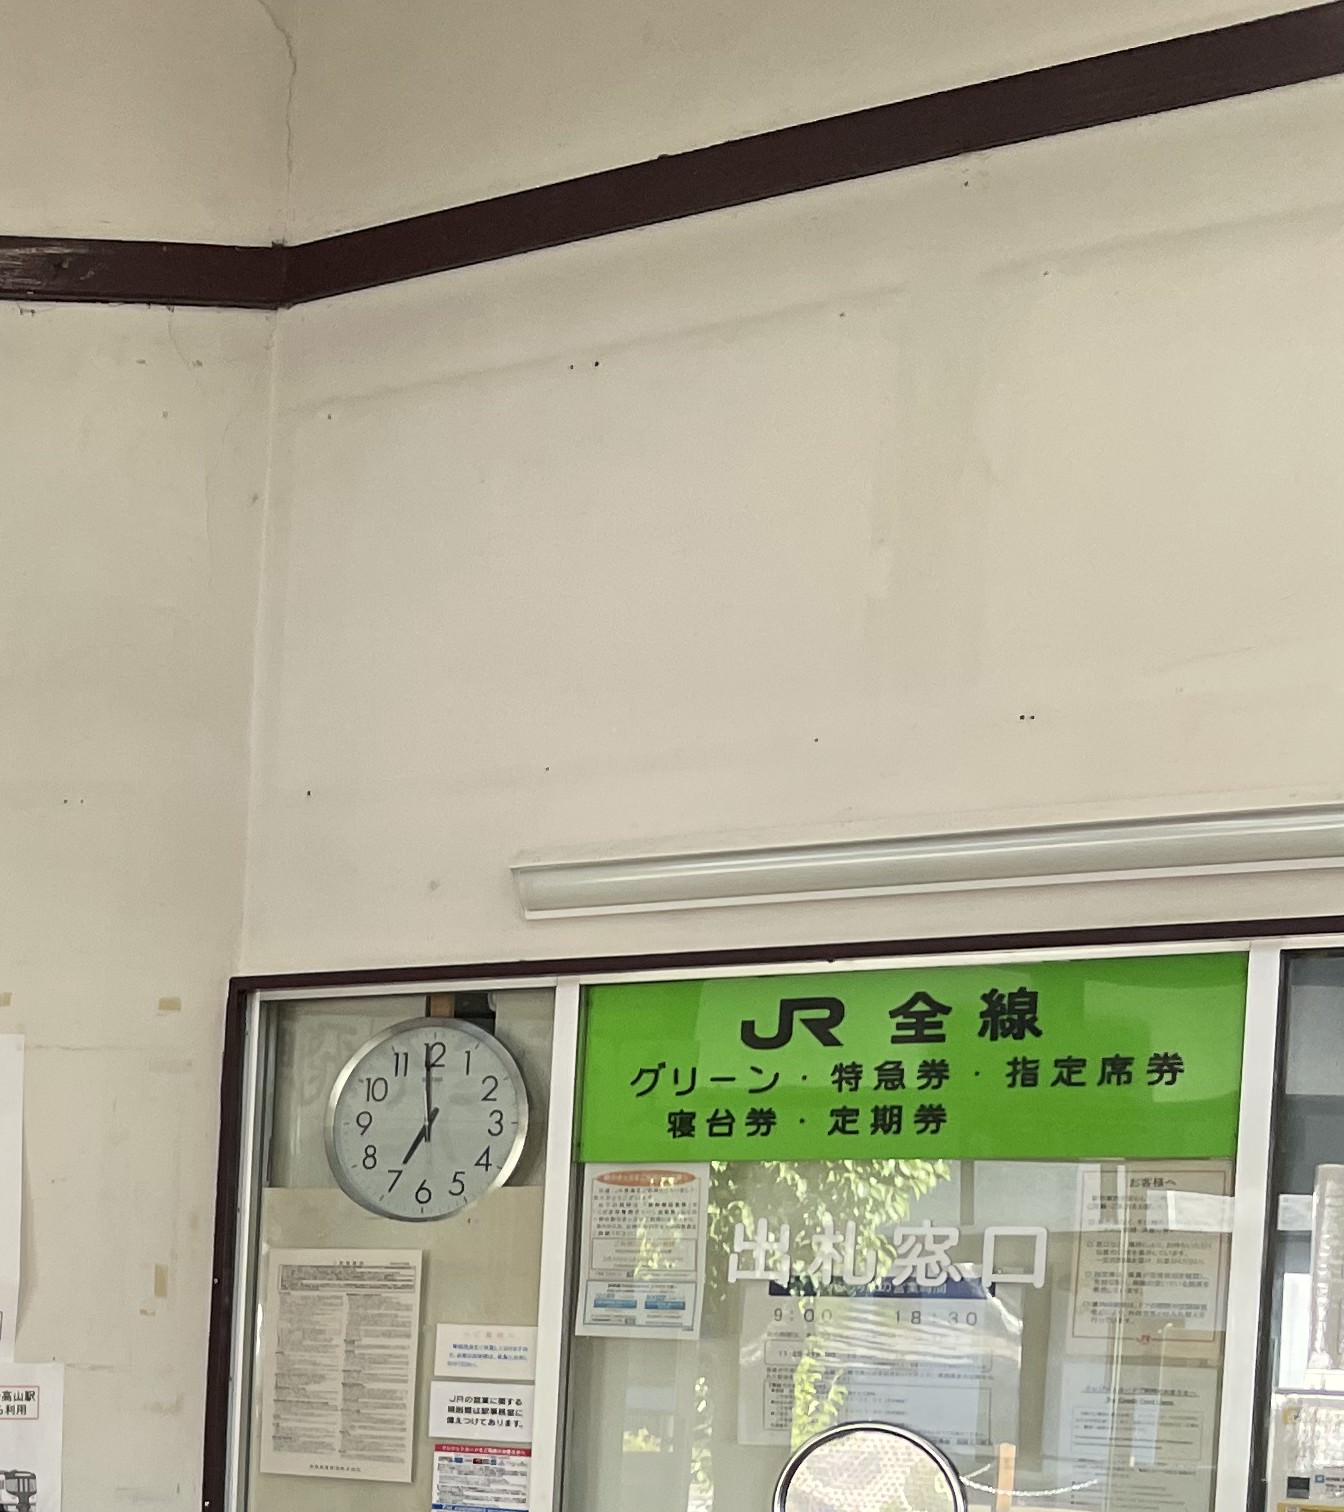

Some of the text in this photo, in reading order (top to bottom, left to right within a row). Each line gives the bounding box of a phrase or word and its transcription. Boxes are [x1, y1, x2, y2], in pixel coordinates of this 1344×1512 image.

[741, 987, 1042, 1050] JR 全線
[394, 1052, 409, 1077] 11
[424, 1042, 446, 1067] 12
[465, 1051, 470, 1075] 1
[630, 1052, 1185, 1098] グリーン・特急券・指定席券
[366, 1078, 388, 1102] 10
[481, 1075, 499, 1101] 2
[356, 1111, 372, 1135] 9
[488, 1110, 503, 1136] 3
[666, 1103, 948, 1139] 寝台券・定期券
[363, 1145, 377, 1169] 8
[474, 1146, 492, 1171] 4
[388, 1169, 403, 1192] 7
[415, 1180, 431, 1204] 6
[449, 1171, 465, 1195] 5
[728, 1217, 1049, 1290] 出札窓口
